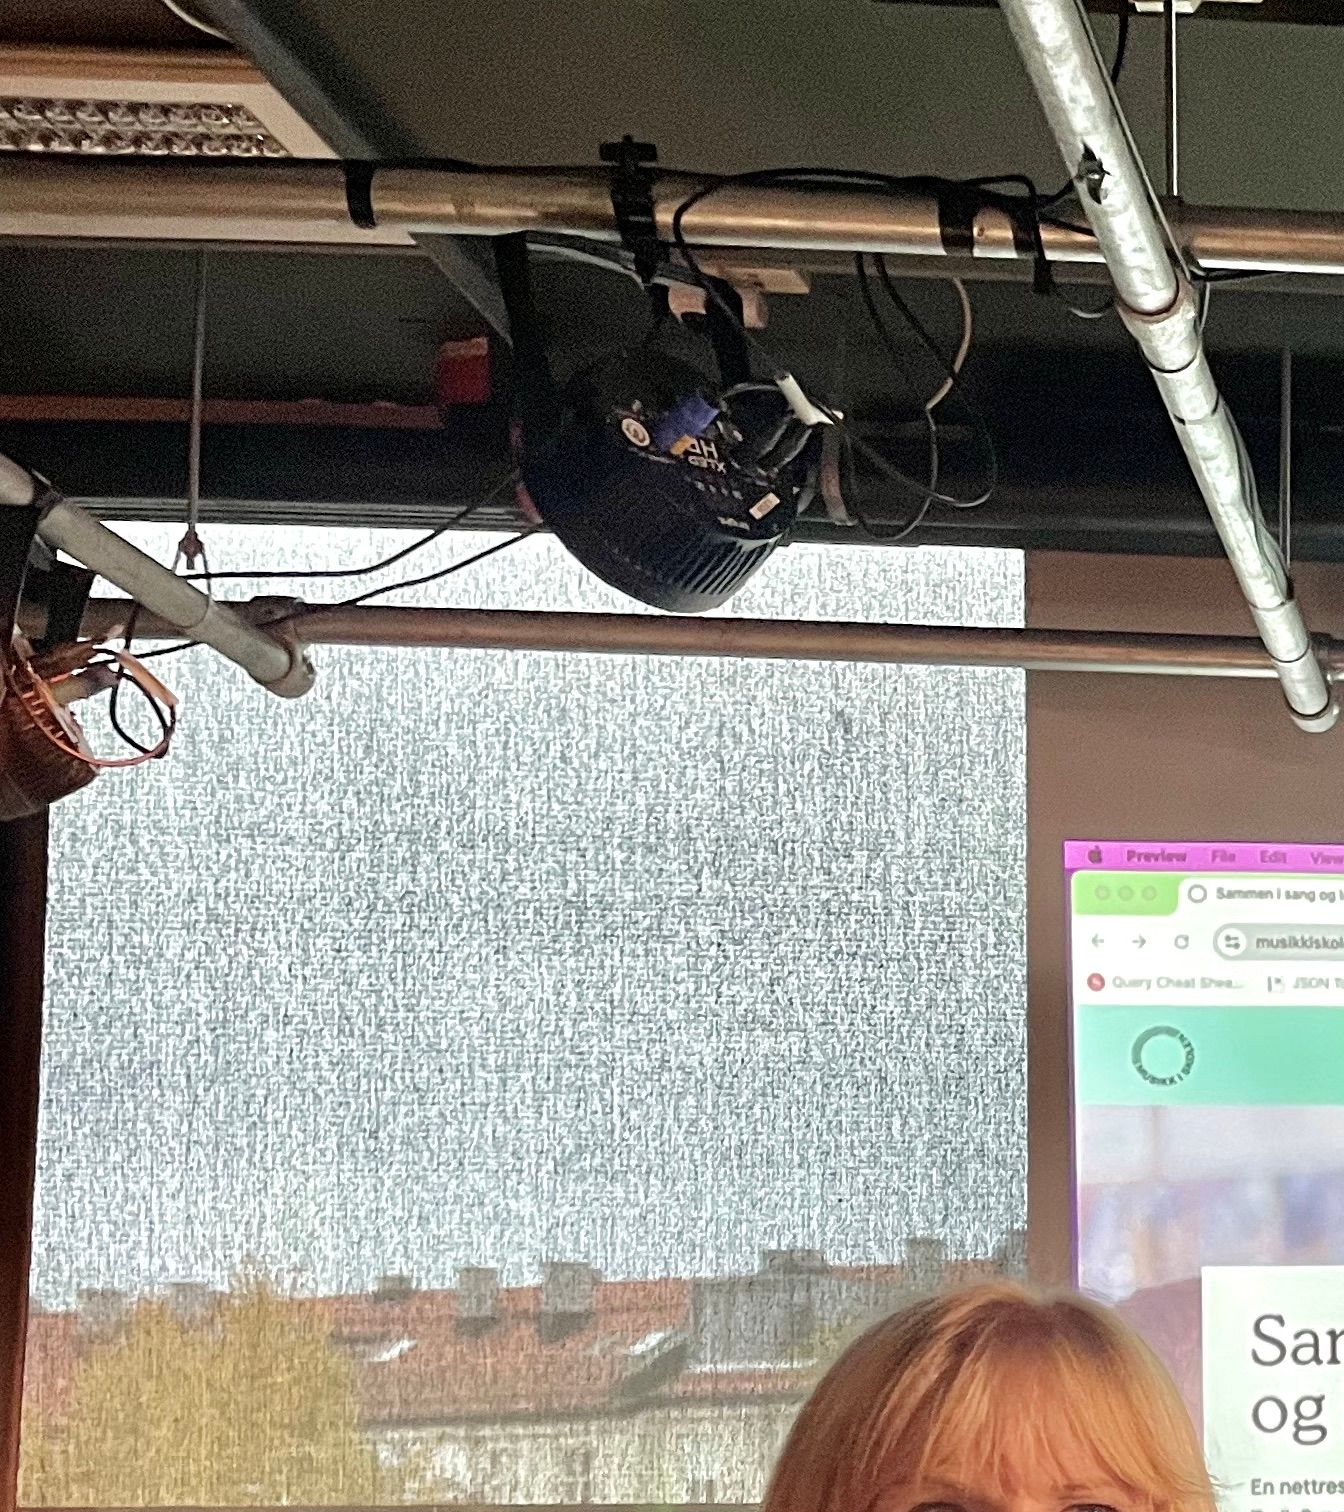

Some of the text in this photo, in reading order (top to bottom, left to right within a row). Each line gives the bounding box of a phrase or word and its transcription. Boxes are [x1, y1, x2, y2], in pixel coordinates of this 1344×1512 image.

[1126, 849, 1187, 863] Preview
[1210, 850, 1237, 863] File
[1259, 850, 1287, 864] Edit
[1310, 851, 1344, 865] View
[1216, 886, 1273, 900] Sammen
[1284, 889, 1315, 903] sang
[1319, 890, 1336, 904] og
[1250, 1396, 1328, 1446] og
[1251, 1478, 1275, 1496] En
